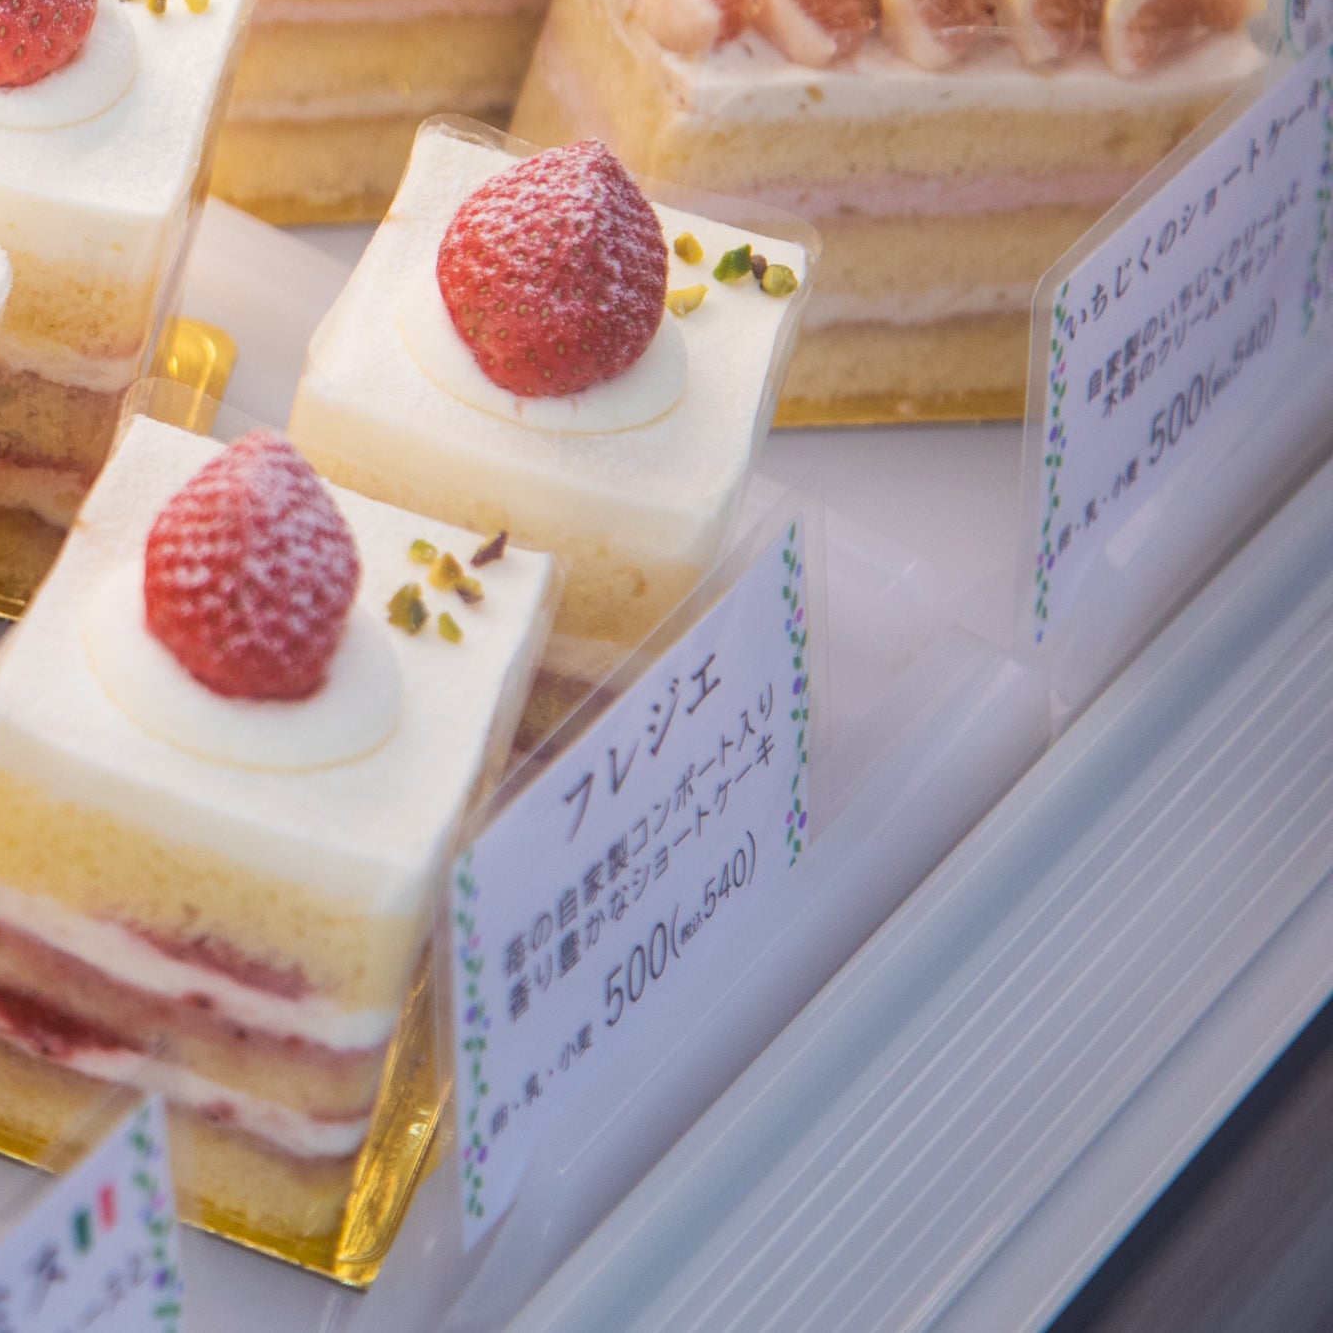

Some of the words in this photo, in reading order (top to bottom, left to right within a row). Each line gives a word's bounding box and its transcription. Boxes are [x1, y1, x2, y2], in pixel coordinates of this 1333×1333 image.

[502, 682, 776, 978] 苺の自家製コンポート入り
[507, 733, 776, 1024] 香り豊かなショートケーキ
[562, 653, 723, 842] フレジエ
